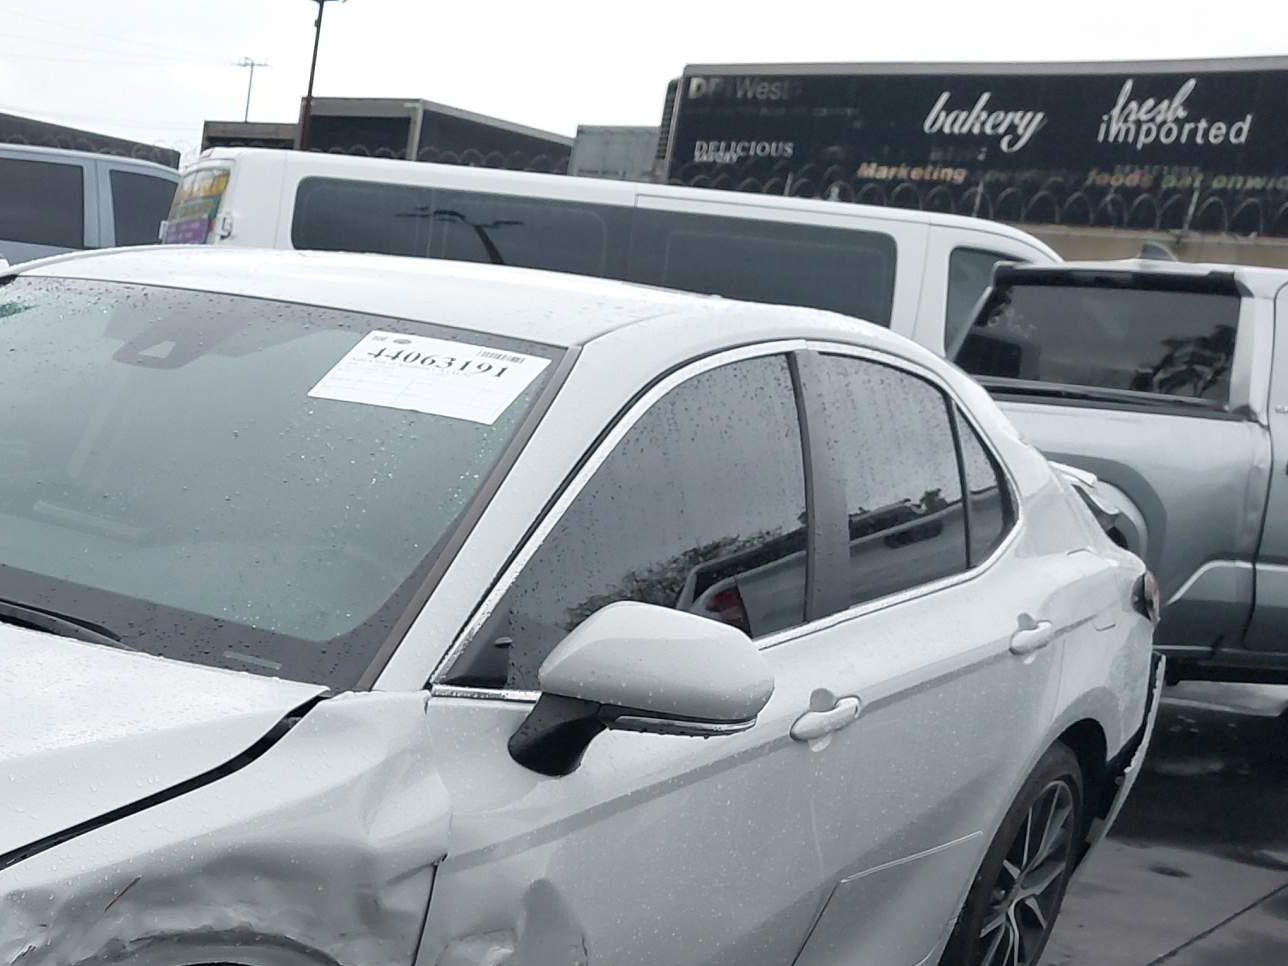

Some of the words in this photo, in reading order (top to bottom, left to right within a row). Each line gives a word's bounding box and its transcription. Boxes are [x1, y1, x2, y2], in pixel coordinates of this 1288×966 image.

[1110, 77, 1198, 124] fresh
[923, 92, 1045, 153] bakery
[1097, 114, 1253, 150] imported
[694, 140, 794, 158] DELICIOUS
[858, 162, 967, 183] Marketing
[368, 347, 508, 378] 44063191
